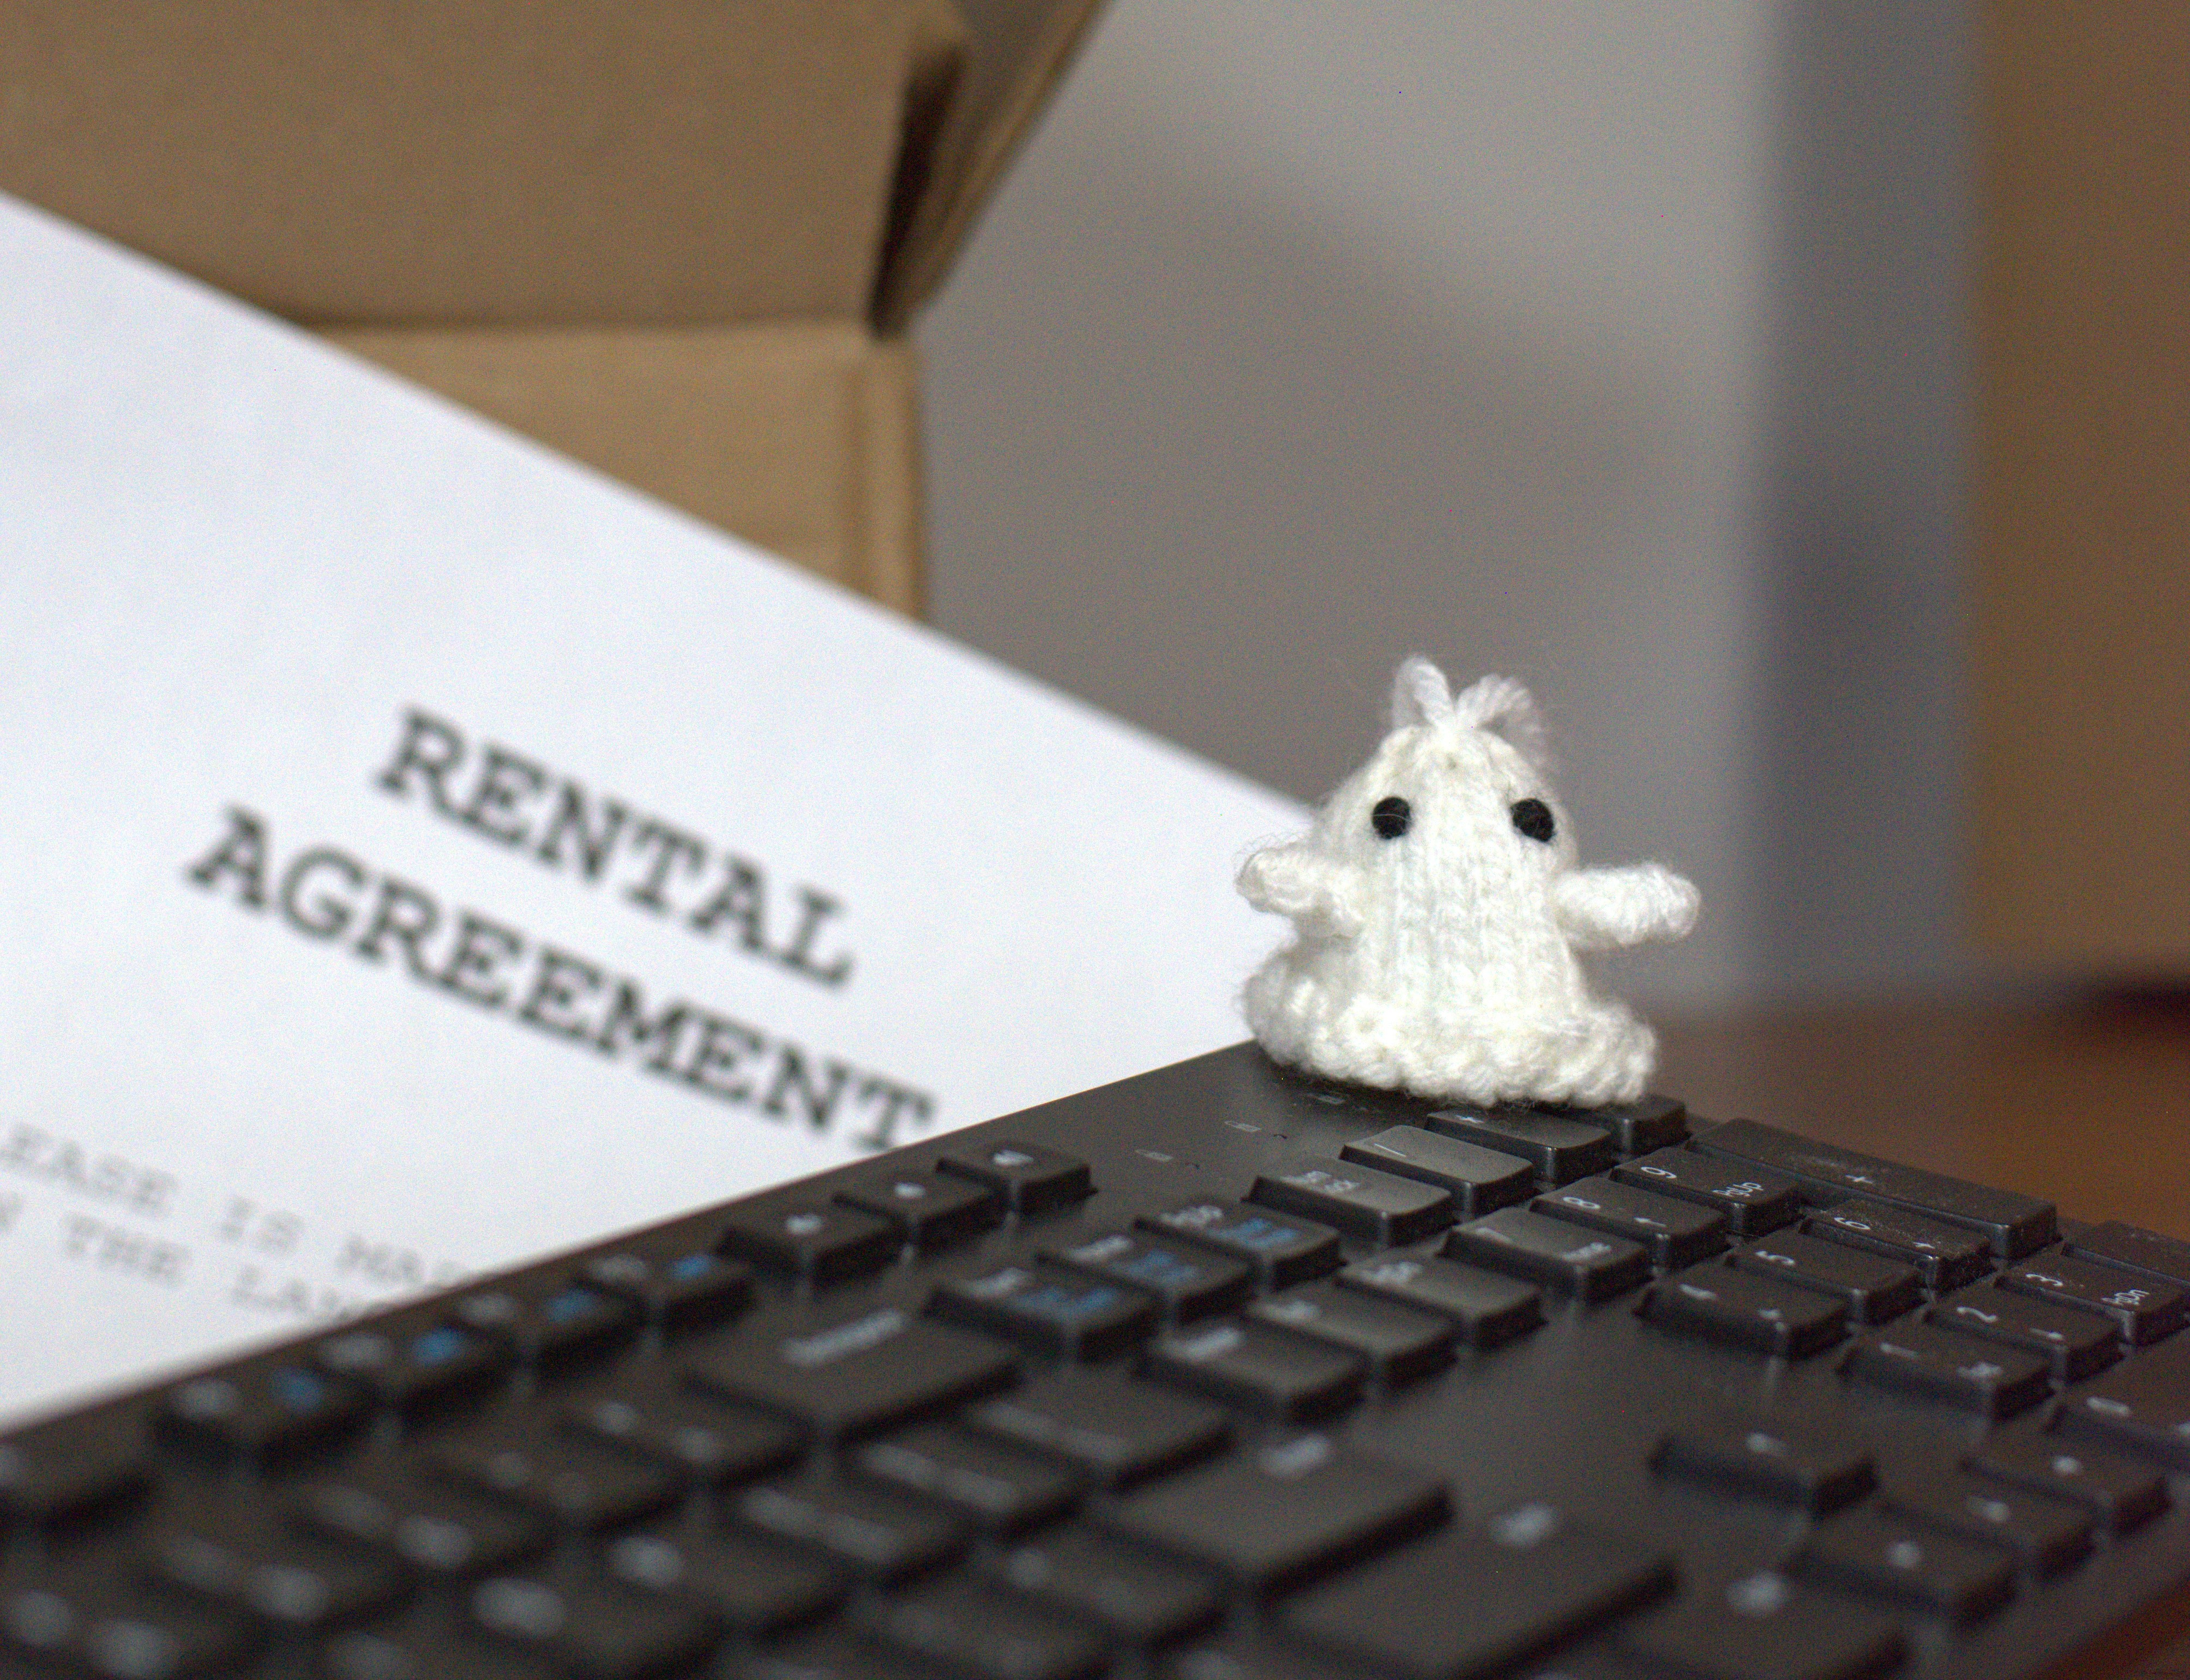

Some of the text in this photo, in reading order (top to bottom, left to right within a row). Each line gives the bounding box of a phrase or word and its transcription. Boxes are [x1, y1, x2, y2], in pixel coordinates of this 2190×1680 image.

[375, 706, 855, 990] RENTAL
[188, 803, 936, 1153] AGREEMENT
[1640, 1166, 1677, 1179] 9
[1712, 1182, 1765, 1198] PgUp
[1561, 1195, 1602, 1211] 8
[1833, 1217, 1871, 1230] 6
[61, 1212, 192, 1288] THE
[1755, 1250, 1796, 1266] 5
[2025, 1273, 2064, 1287] 3
[2101, 1289, 2150, 1305] PgDn
[1956, 1306, 1999, 1323] 2
